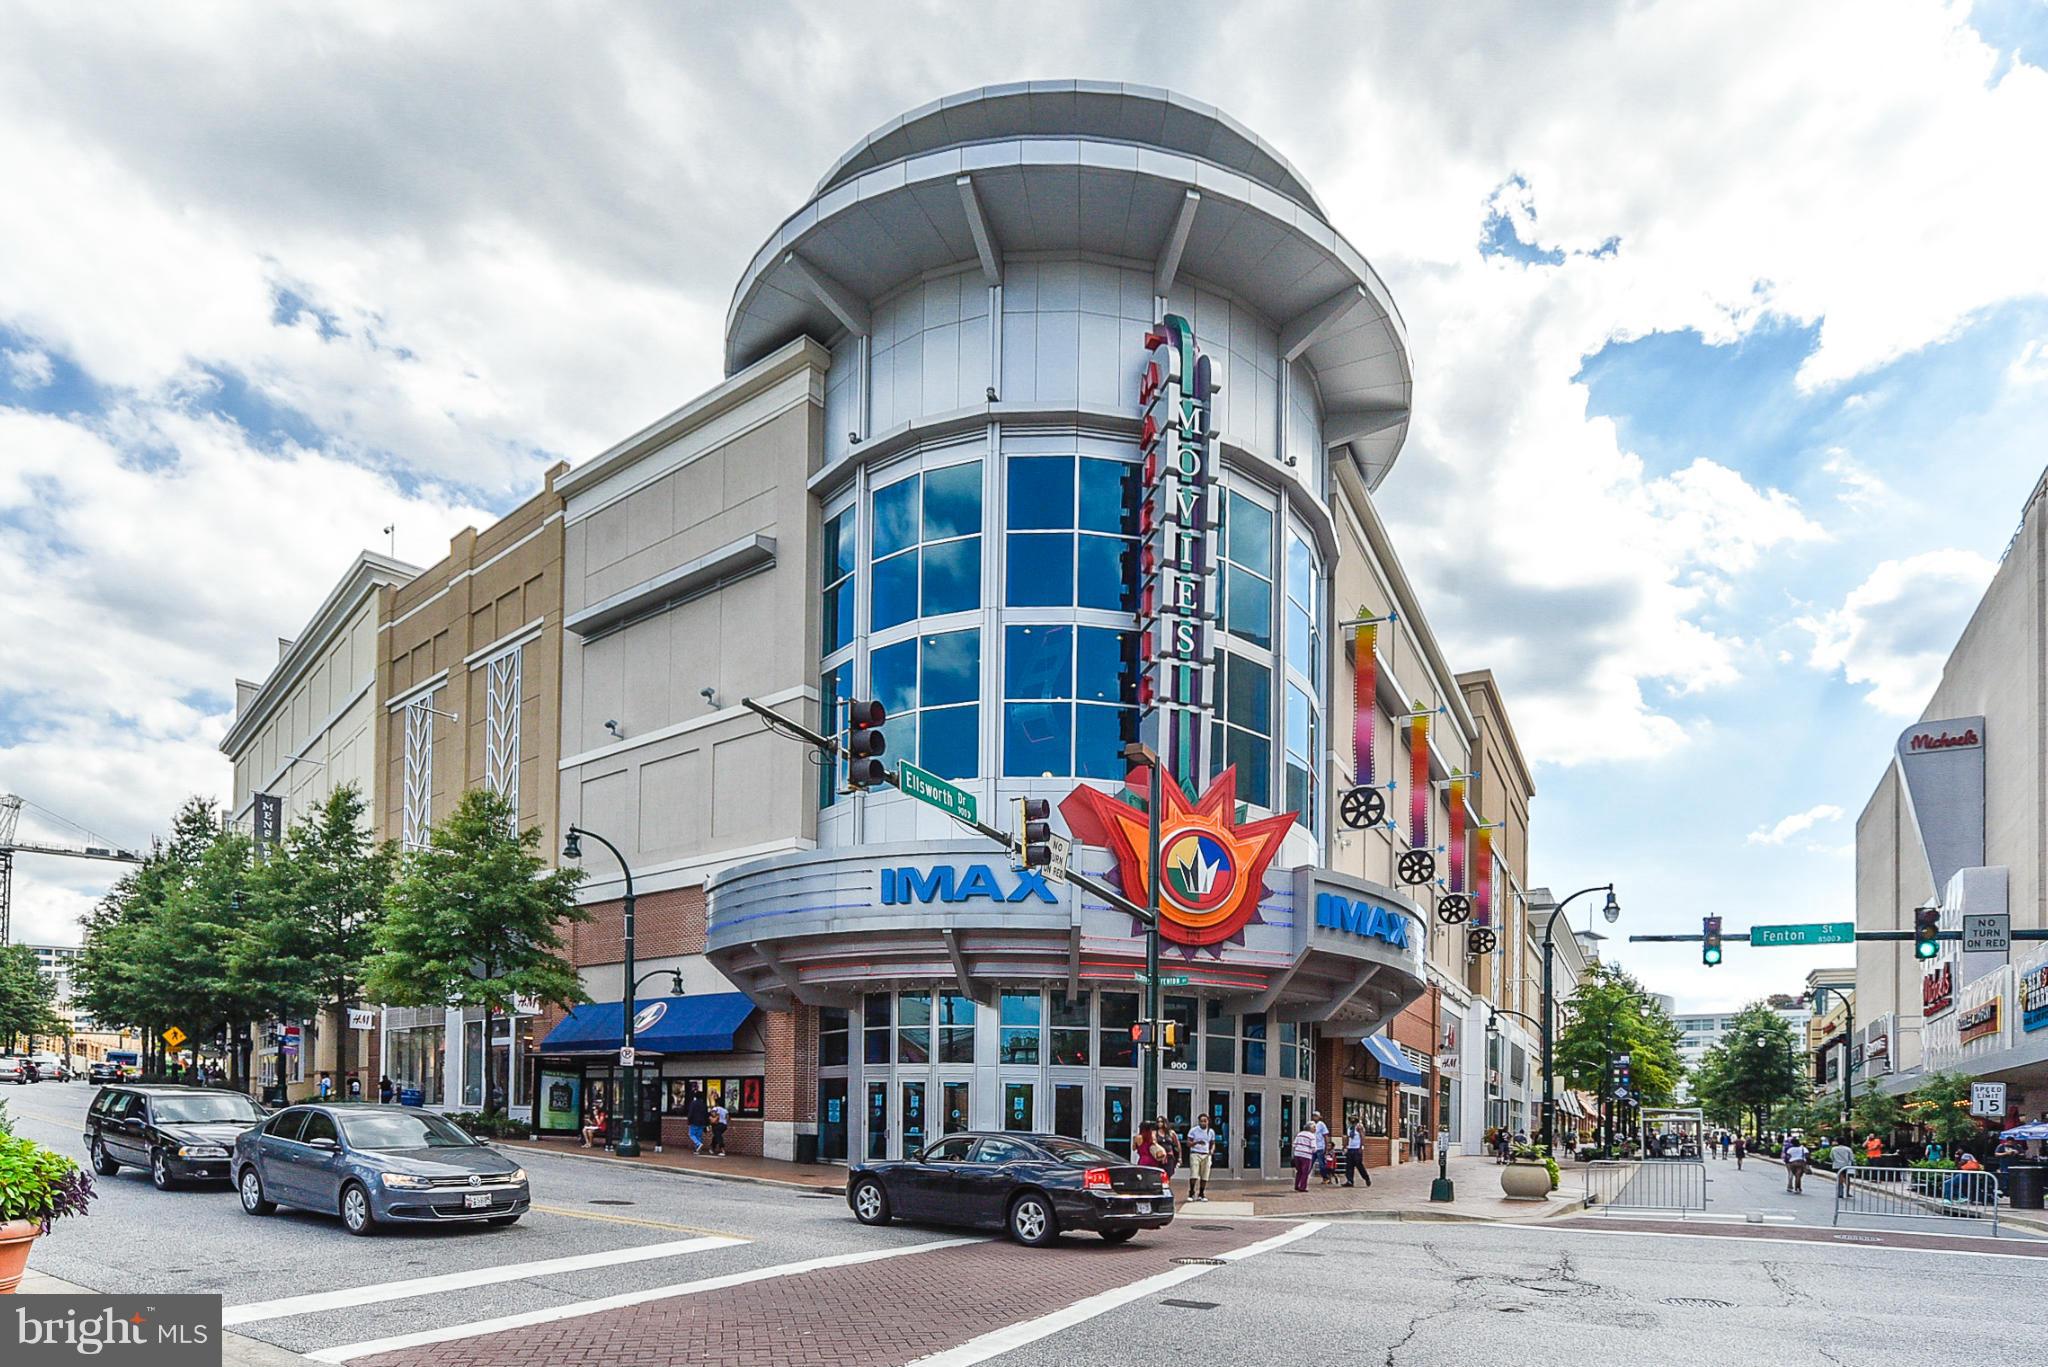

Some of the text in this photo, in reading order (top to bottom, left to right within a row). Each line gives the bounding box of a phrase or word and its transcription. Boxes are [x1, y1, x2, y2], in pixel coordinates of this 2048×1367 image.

[1175, 400, 1203, 654] MOVIES
[1911, 730, 1979, 751] Michaels
[906, 770, 966, 807] Ellsworth Dr
[262, 802, 274, 838] MENS
[1053, 840, 1063, 852] NO
[1051, 853, 1063, 866] URN
[881, 865, 1059, 905] IMAX
[1316, 892, 1409, 949] IMAX
[1978, 919, 1996, 927] NO
[1763, 930, 1805, 942] Fenton
[1973, 929, 2001, 937] TURN
[1967, 939, 2006, 948] ON RED
[1980, 1100, 1999, 1112] 15
